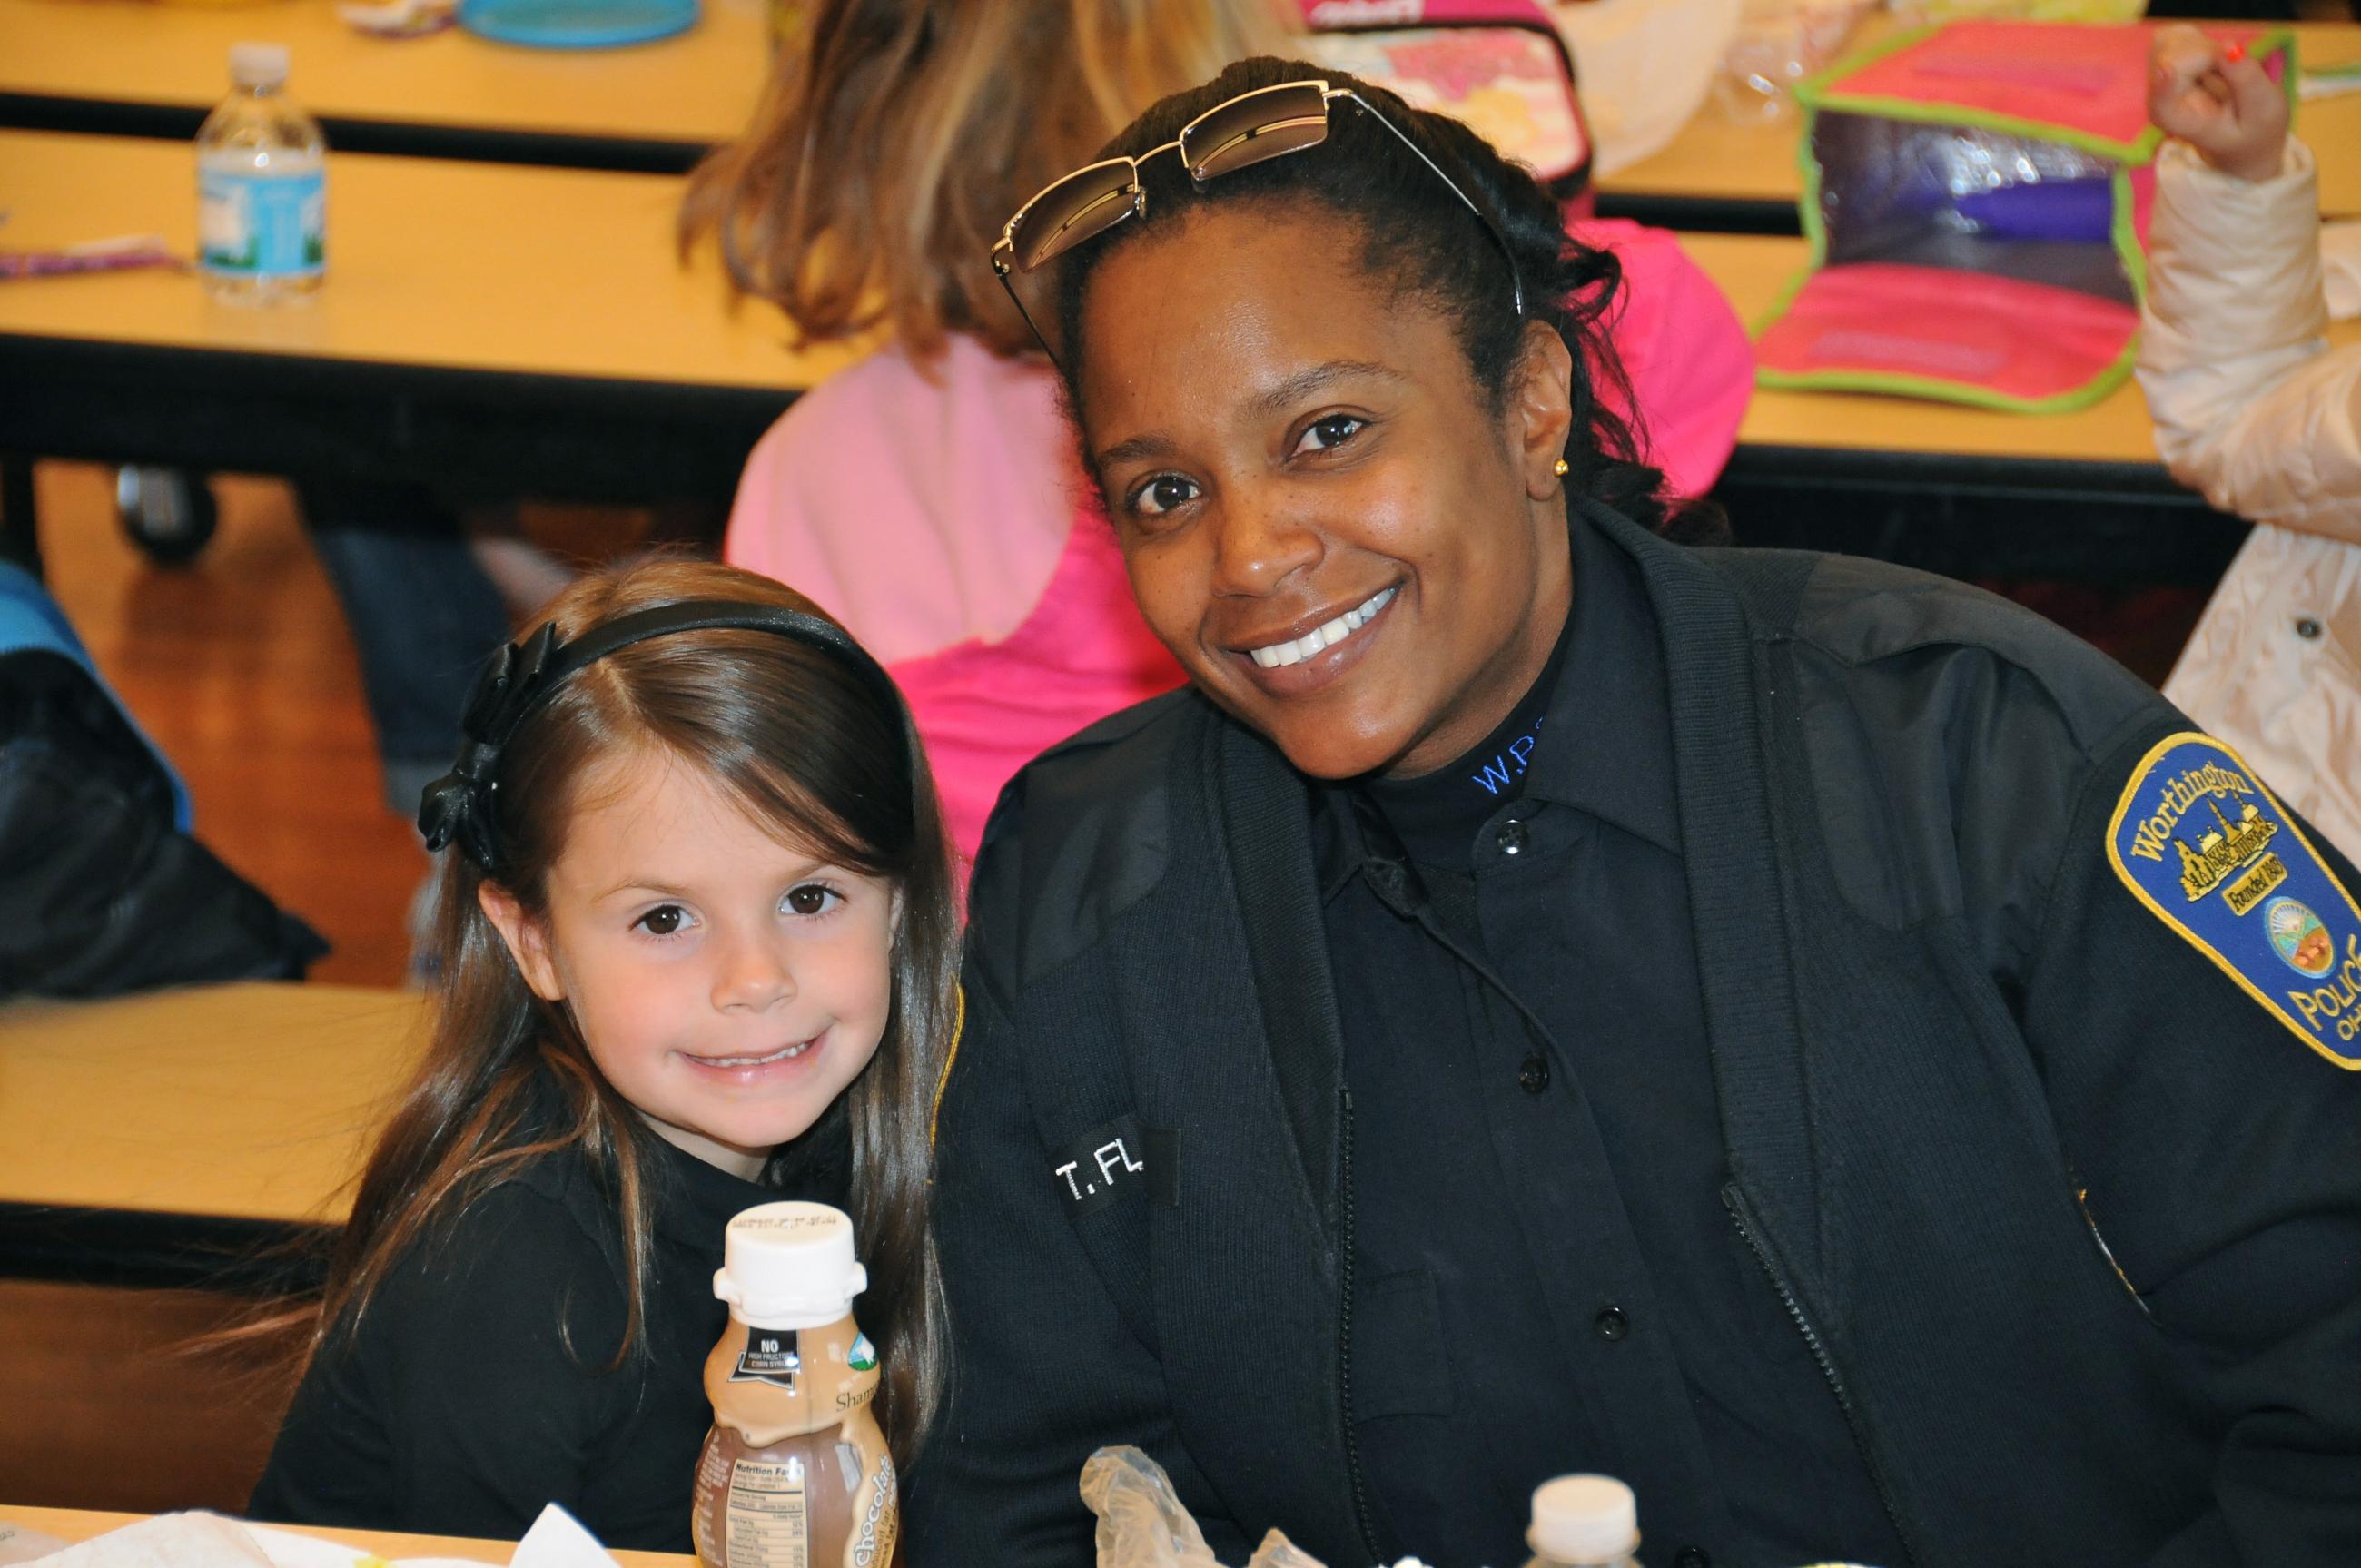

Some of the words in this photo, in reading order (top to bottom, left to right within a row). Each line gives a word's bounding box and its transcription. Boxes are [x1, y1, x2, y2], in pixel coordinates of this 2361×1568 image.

[1472, 716, 1543, 794] W.P
[2131, 760, 2254, 862] Worthington
[2228, 868, 2269, 912] Founded
[1055, 1160, 1095, 1200] T.
[1093, 1138, 1143, 1186] FL
[761, 1339, 779, 1353] NO
[736, 1463, 772, 1475] Nutrition
